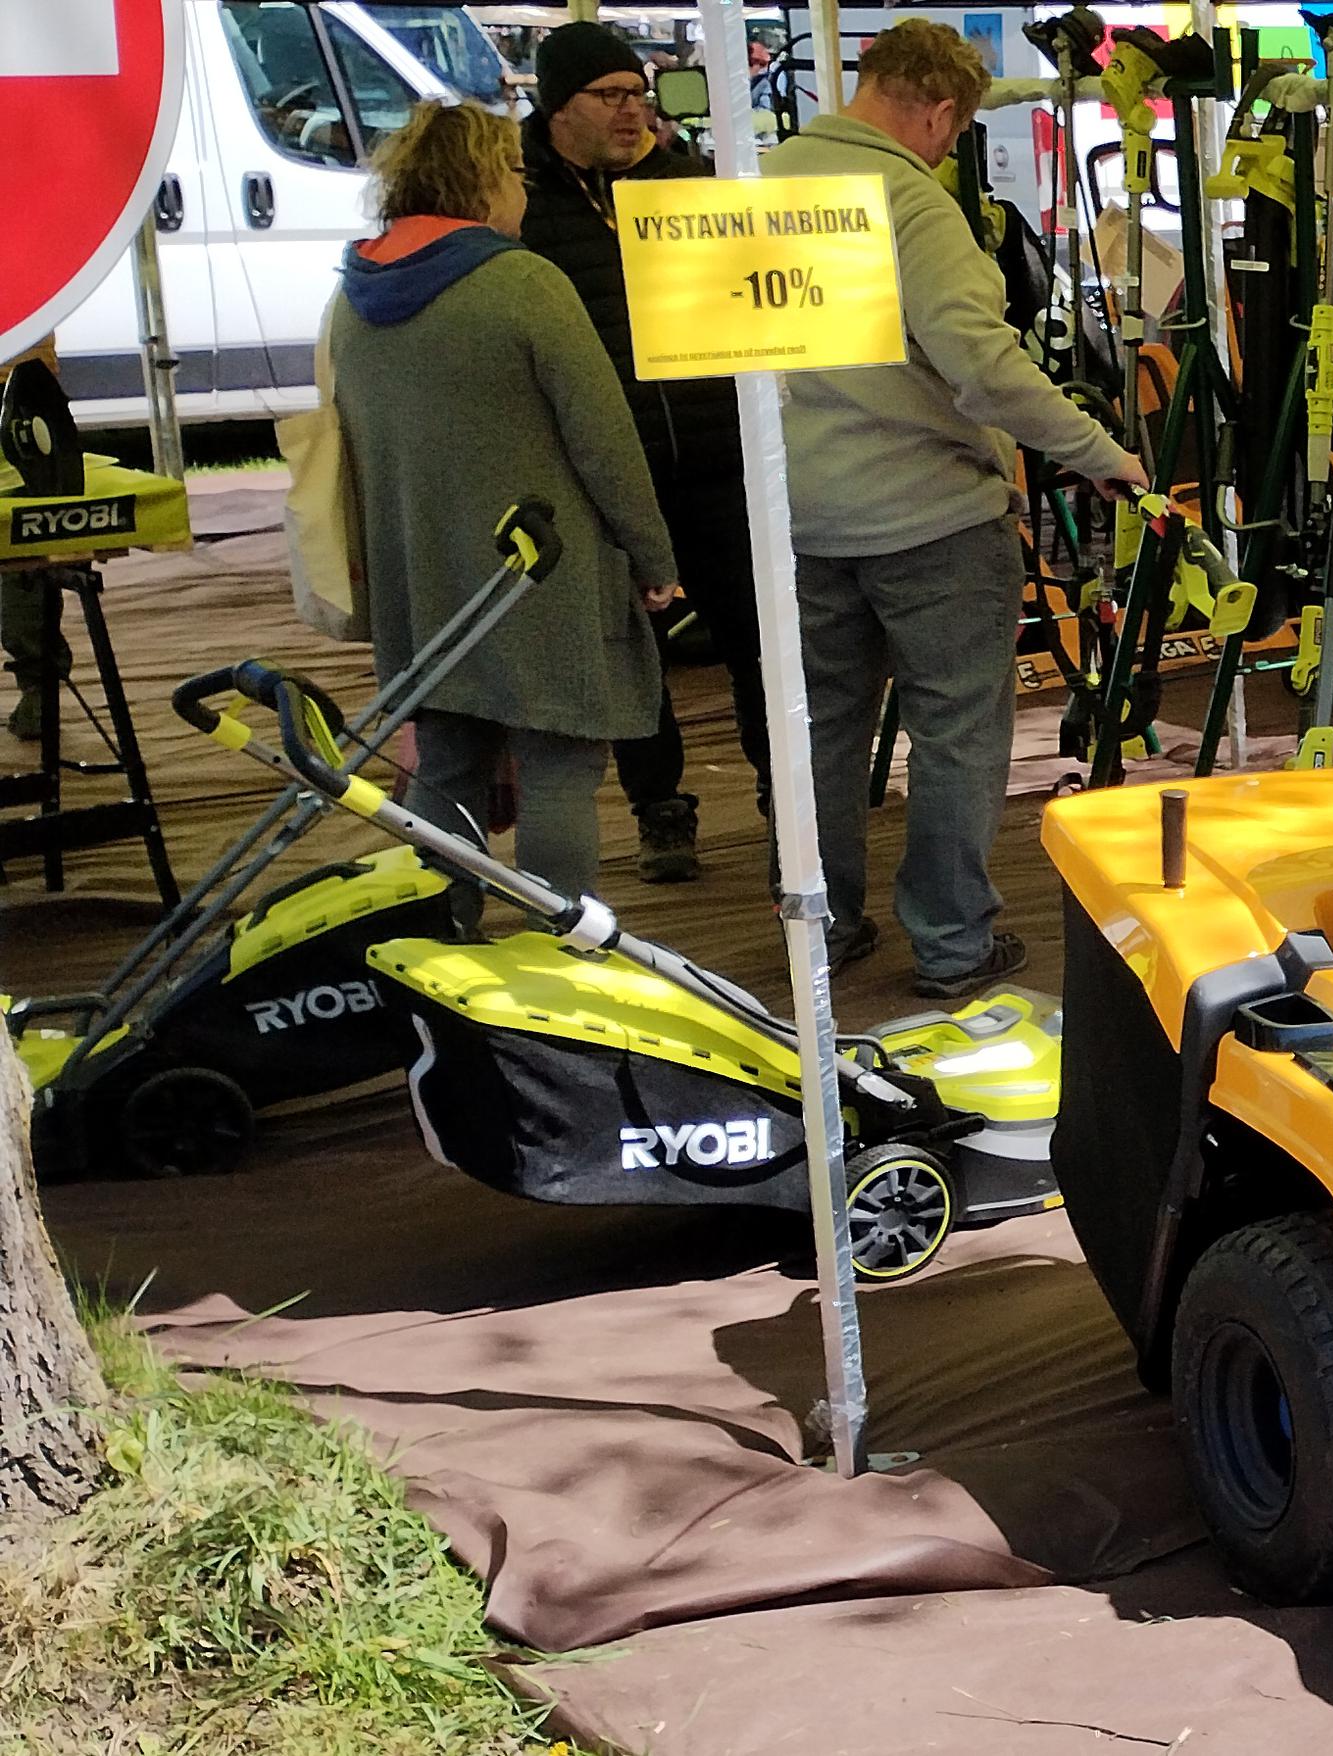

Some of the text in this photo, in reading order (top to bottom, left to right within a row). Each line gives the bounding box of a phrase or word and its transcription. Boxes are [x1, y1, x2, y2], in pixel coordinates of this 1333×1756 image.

[633, 205, 871, 241] VÝSTAVNÍ NABÍDKA
[730, 266, 823, 309] -10%
[22, 503, 118, 537] RYOBI
[245, 980, 386, 1034] RYOBI
[620, 1118, 773, 1169] RYOBI
